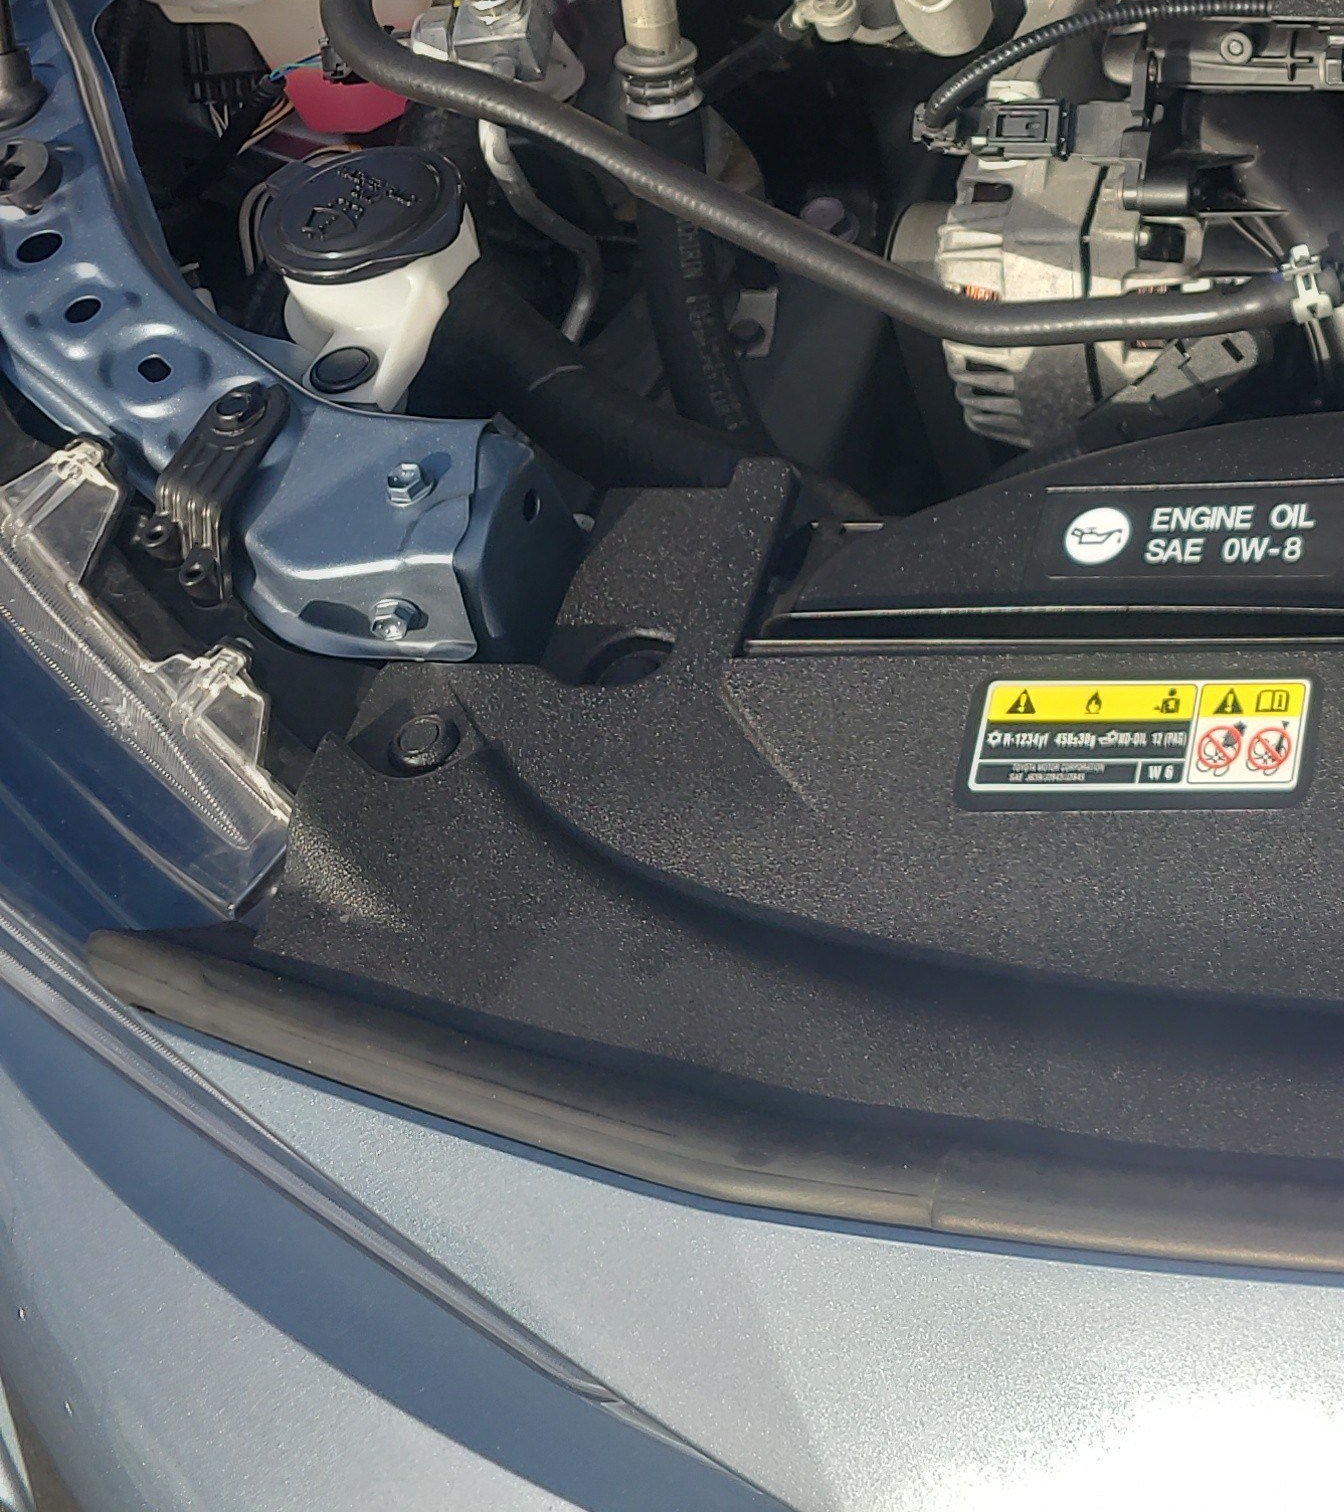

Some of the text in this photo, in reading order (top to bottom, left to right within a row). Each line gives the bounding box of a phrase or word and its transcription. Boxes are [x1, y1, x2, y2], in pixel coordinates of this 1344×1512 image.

[1150, 502, 1315, 533] ENGINE OIL
[1144, 536, 1303, 565] SAE 0W-8
